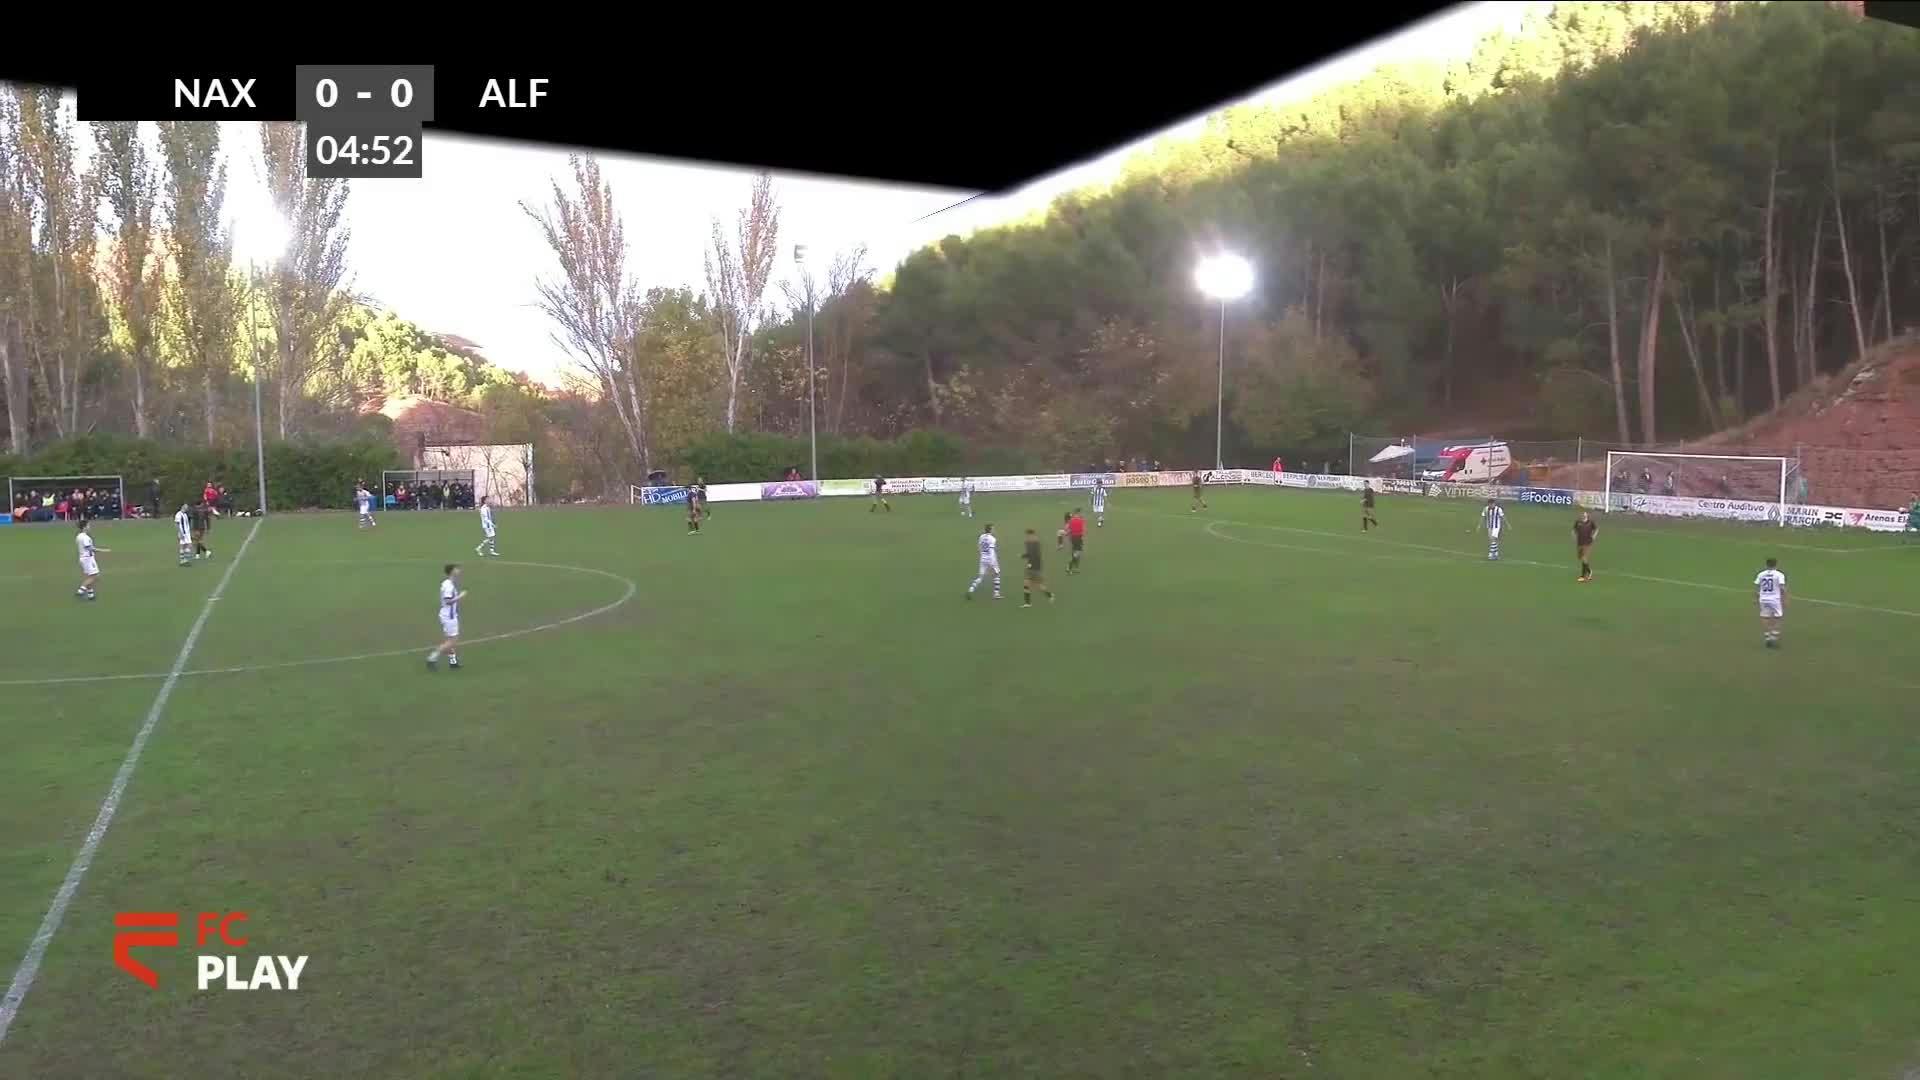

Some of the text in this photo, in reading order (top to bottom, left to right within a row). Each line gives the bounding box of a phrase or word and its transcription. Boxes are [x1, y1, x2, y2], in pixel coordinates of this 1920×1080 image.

[1529, 492, 1572, 505] Footters
[1698, 500, 1725, 509] Centro
[1727, 503, 1765, 512] Auditivo
[1864, 513, 1895, 523] Arenas
[1761, 578, 1774, 592] 20
